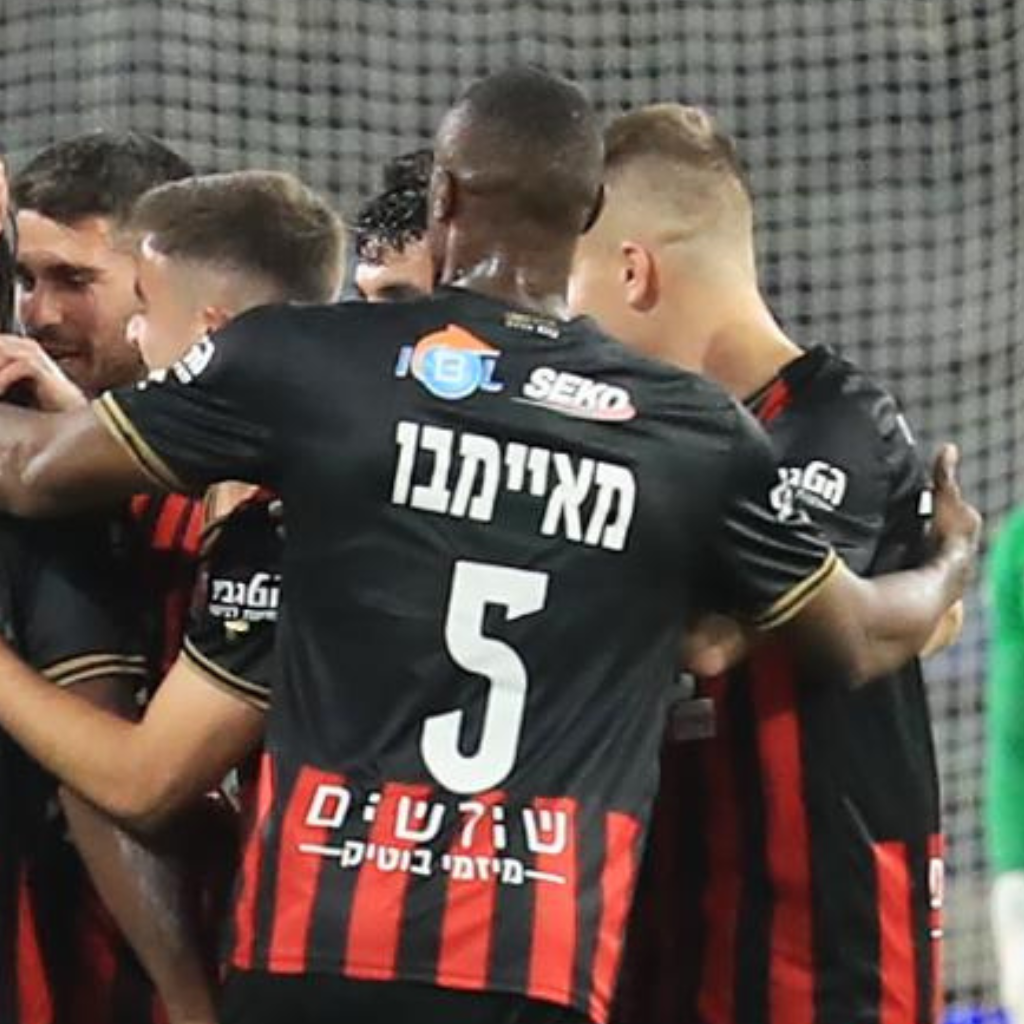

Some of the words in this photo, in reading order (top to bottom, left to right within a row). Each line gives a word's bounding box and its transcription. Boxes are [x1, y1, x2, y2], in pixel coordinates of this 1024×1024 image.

[523, 366, 632, 412] SEKO
[392, 421, 636, 551] מאיימבו
[420, 560, 550, 794] 5
[340, 840, 432, 876] בוטיק
[442, 853, 525, 885] מיזמי
